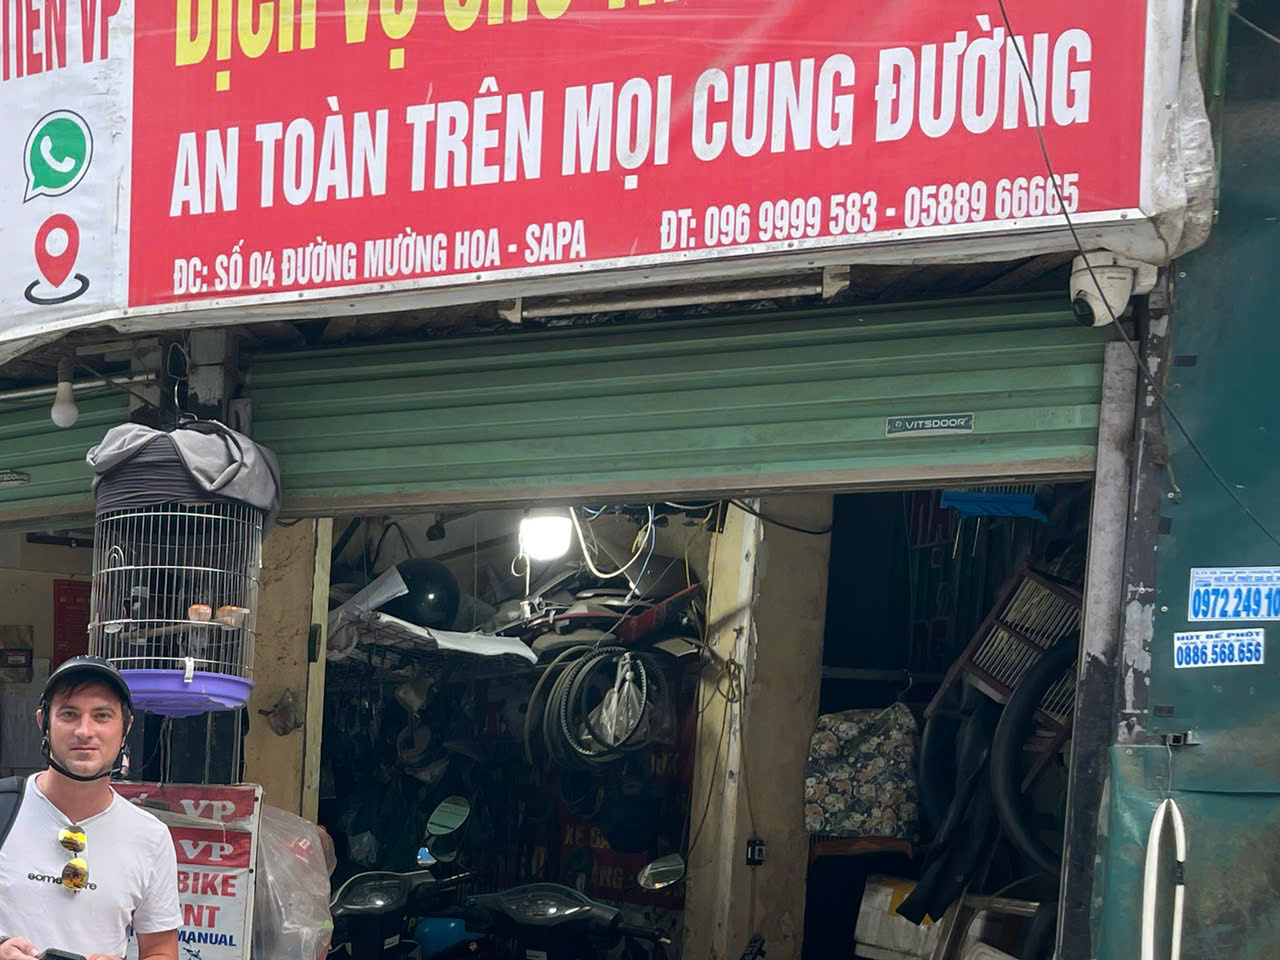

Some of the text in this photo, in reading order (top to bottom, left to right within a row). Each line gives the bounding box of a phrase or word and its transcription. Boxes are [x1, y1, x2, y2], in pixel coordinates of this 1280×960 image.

[175, 0, 316, 91] DỊCH
[170, 15, 1092, 217] AN TOÀN TRÊN MỌI CUNG ĐƯỜNG
[660, 173, 1079, 251] ĐT: 096 9999 583 05889 66665
[173, 219, 587, 294] ĐC: SỐ 04 ĐƯỜNG MƯỜNG HOA SAPA
[905, 416, 967, 430] VITSDOOR
[1176, 642, 1262, 667] 0886.568.656
[180, 799, 236, 823] VP
[179, 840, 234, 861] VP
[28, 872, 97, 891] somere
